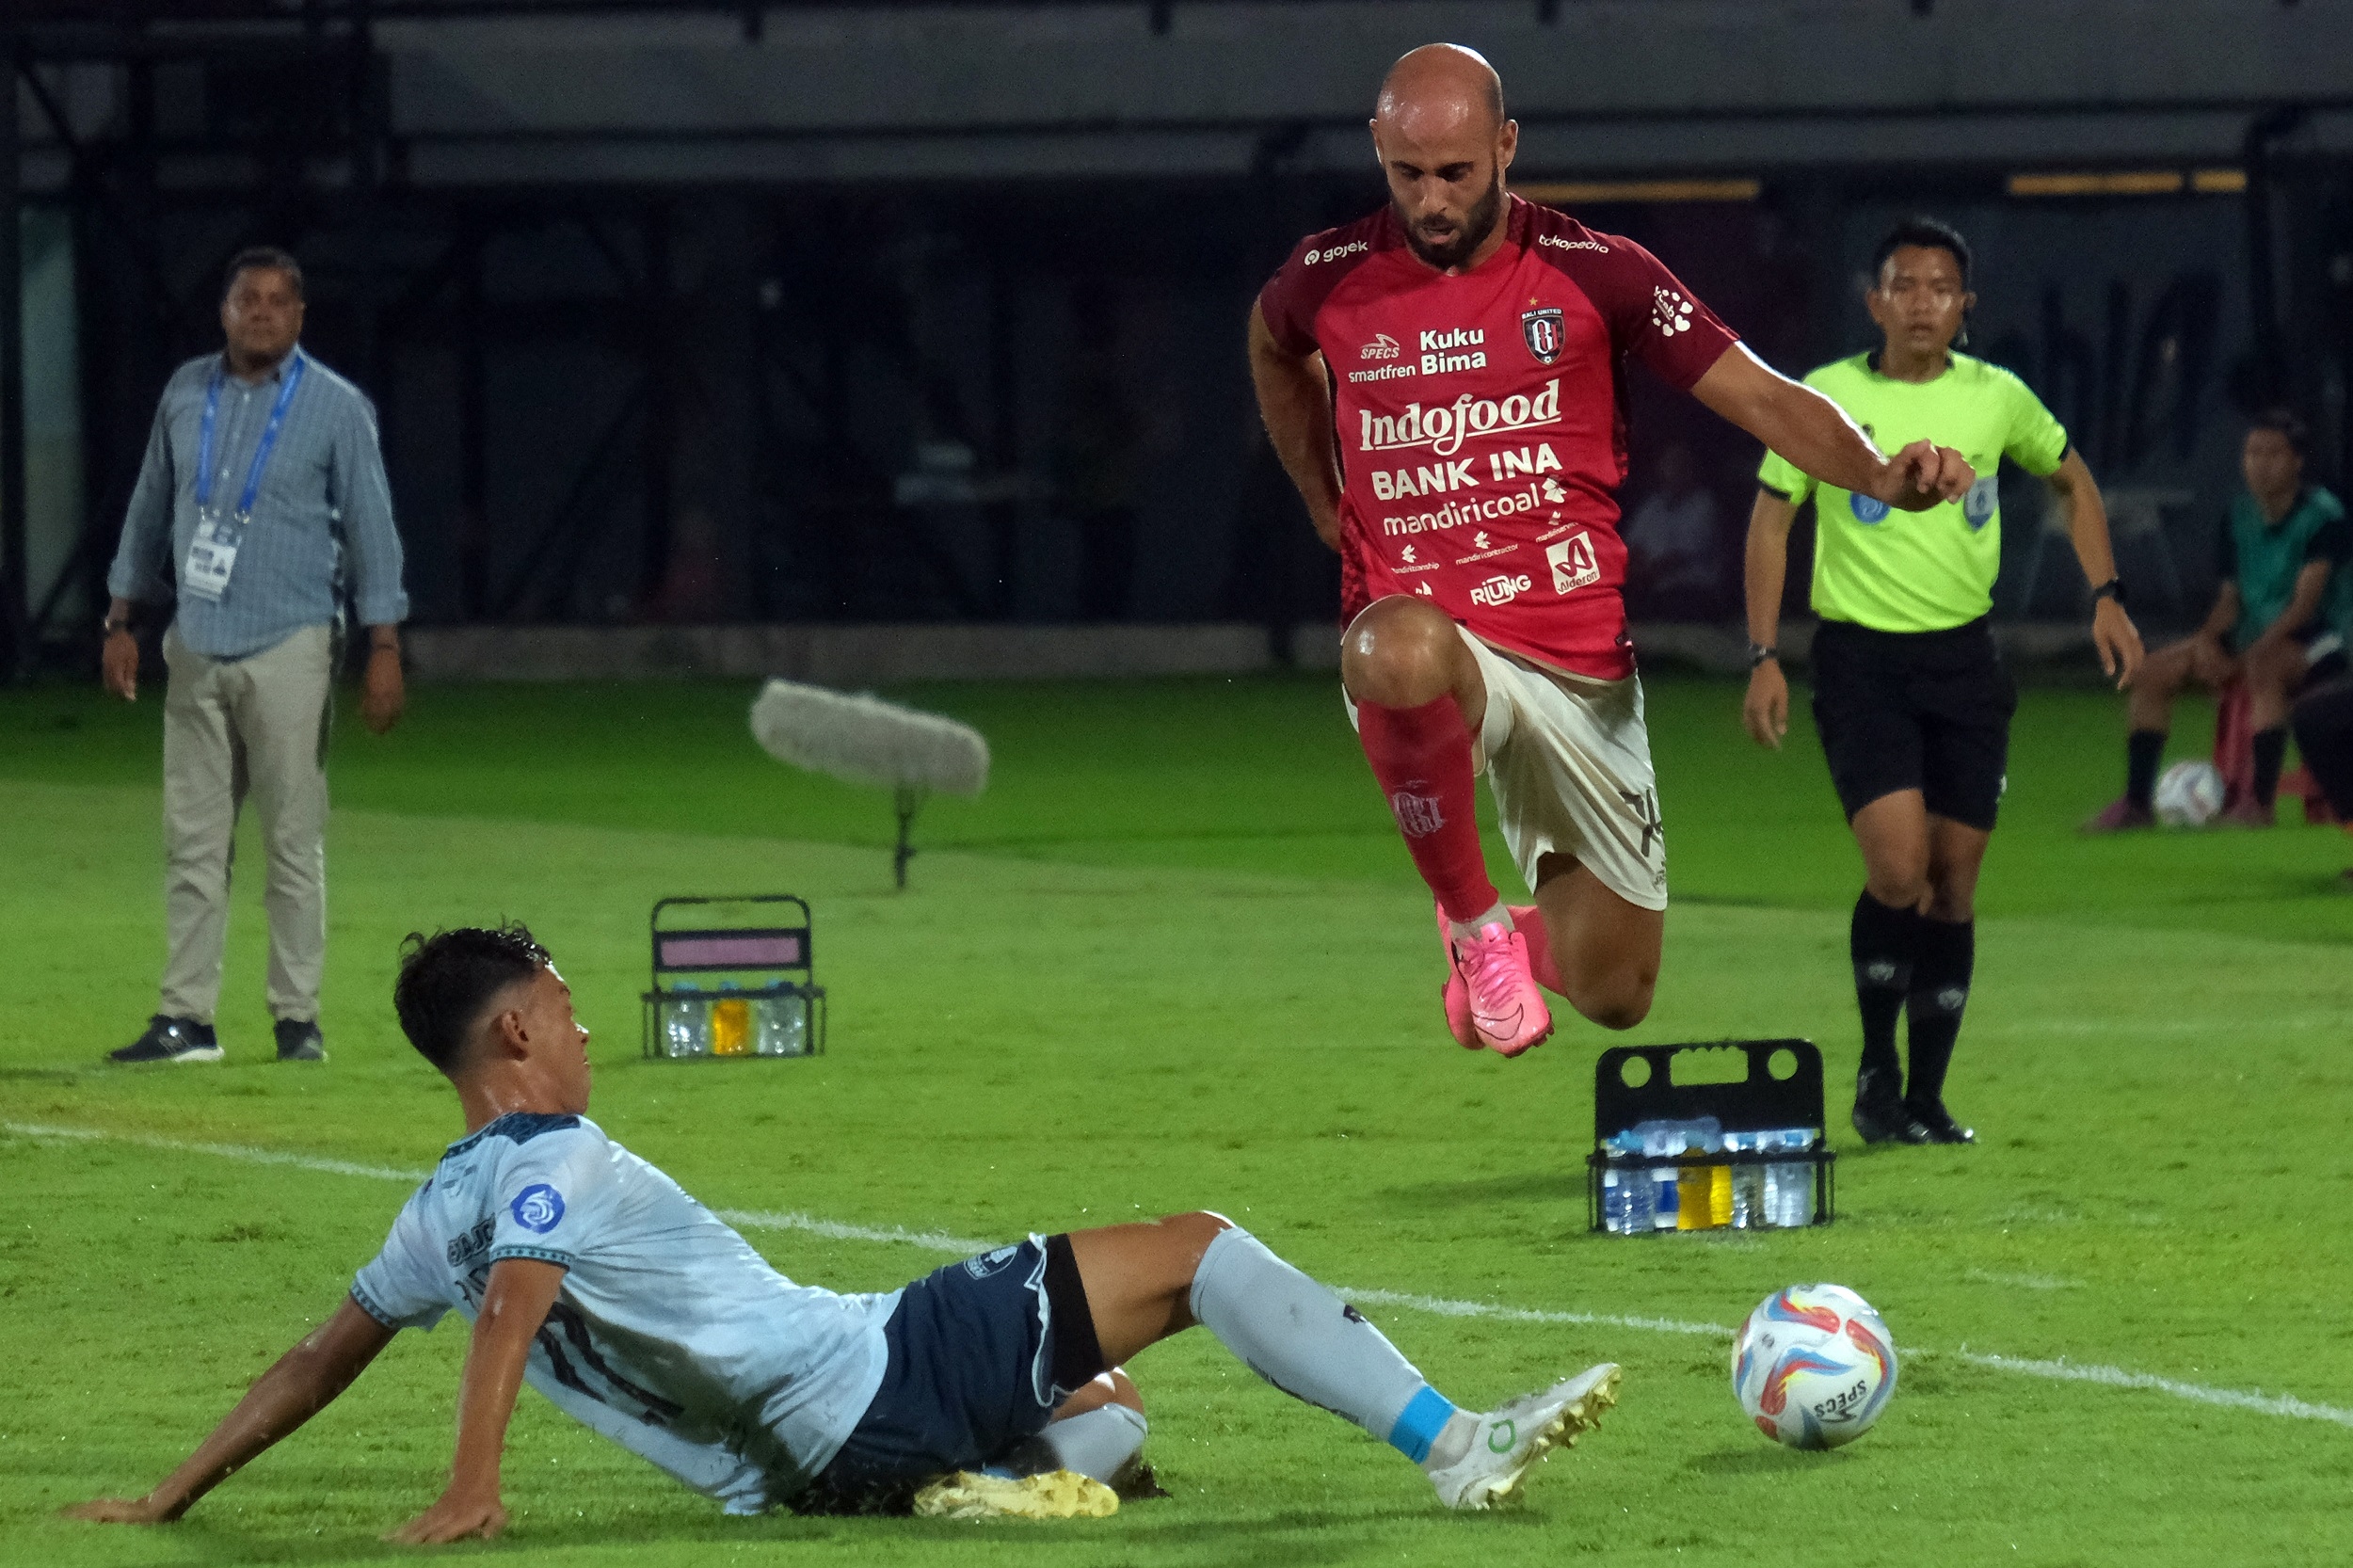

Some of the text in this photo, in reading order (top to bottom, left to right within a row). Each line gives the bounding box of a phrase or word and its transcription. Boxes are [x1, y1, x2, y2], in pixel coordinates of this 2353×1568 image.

[1322, 240, 1369, 263] gojek
[1539, 234, 1609, 254] tokopedia
[1419, 328, 1485, 352] Kuku
[1360, 346, 1401, 360] SPECS
[1420, 351, 1487, 376] Bima
[1348, 364, 1417, 383] smartfren
[1358, 378, 1562, 456] Indofood
[1371, 442, 1563, 501] BANK INA
[1383, 483, 1541, 536] mandiricoal
[1558, 571, 1597, 592] Alderon
[1814, 1380, 1867, 1417] SPECS
